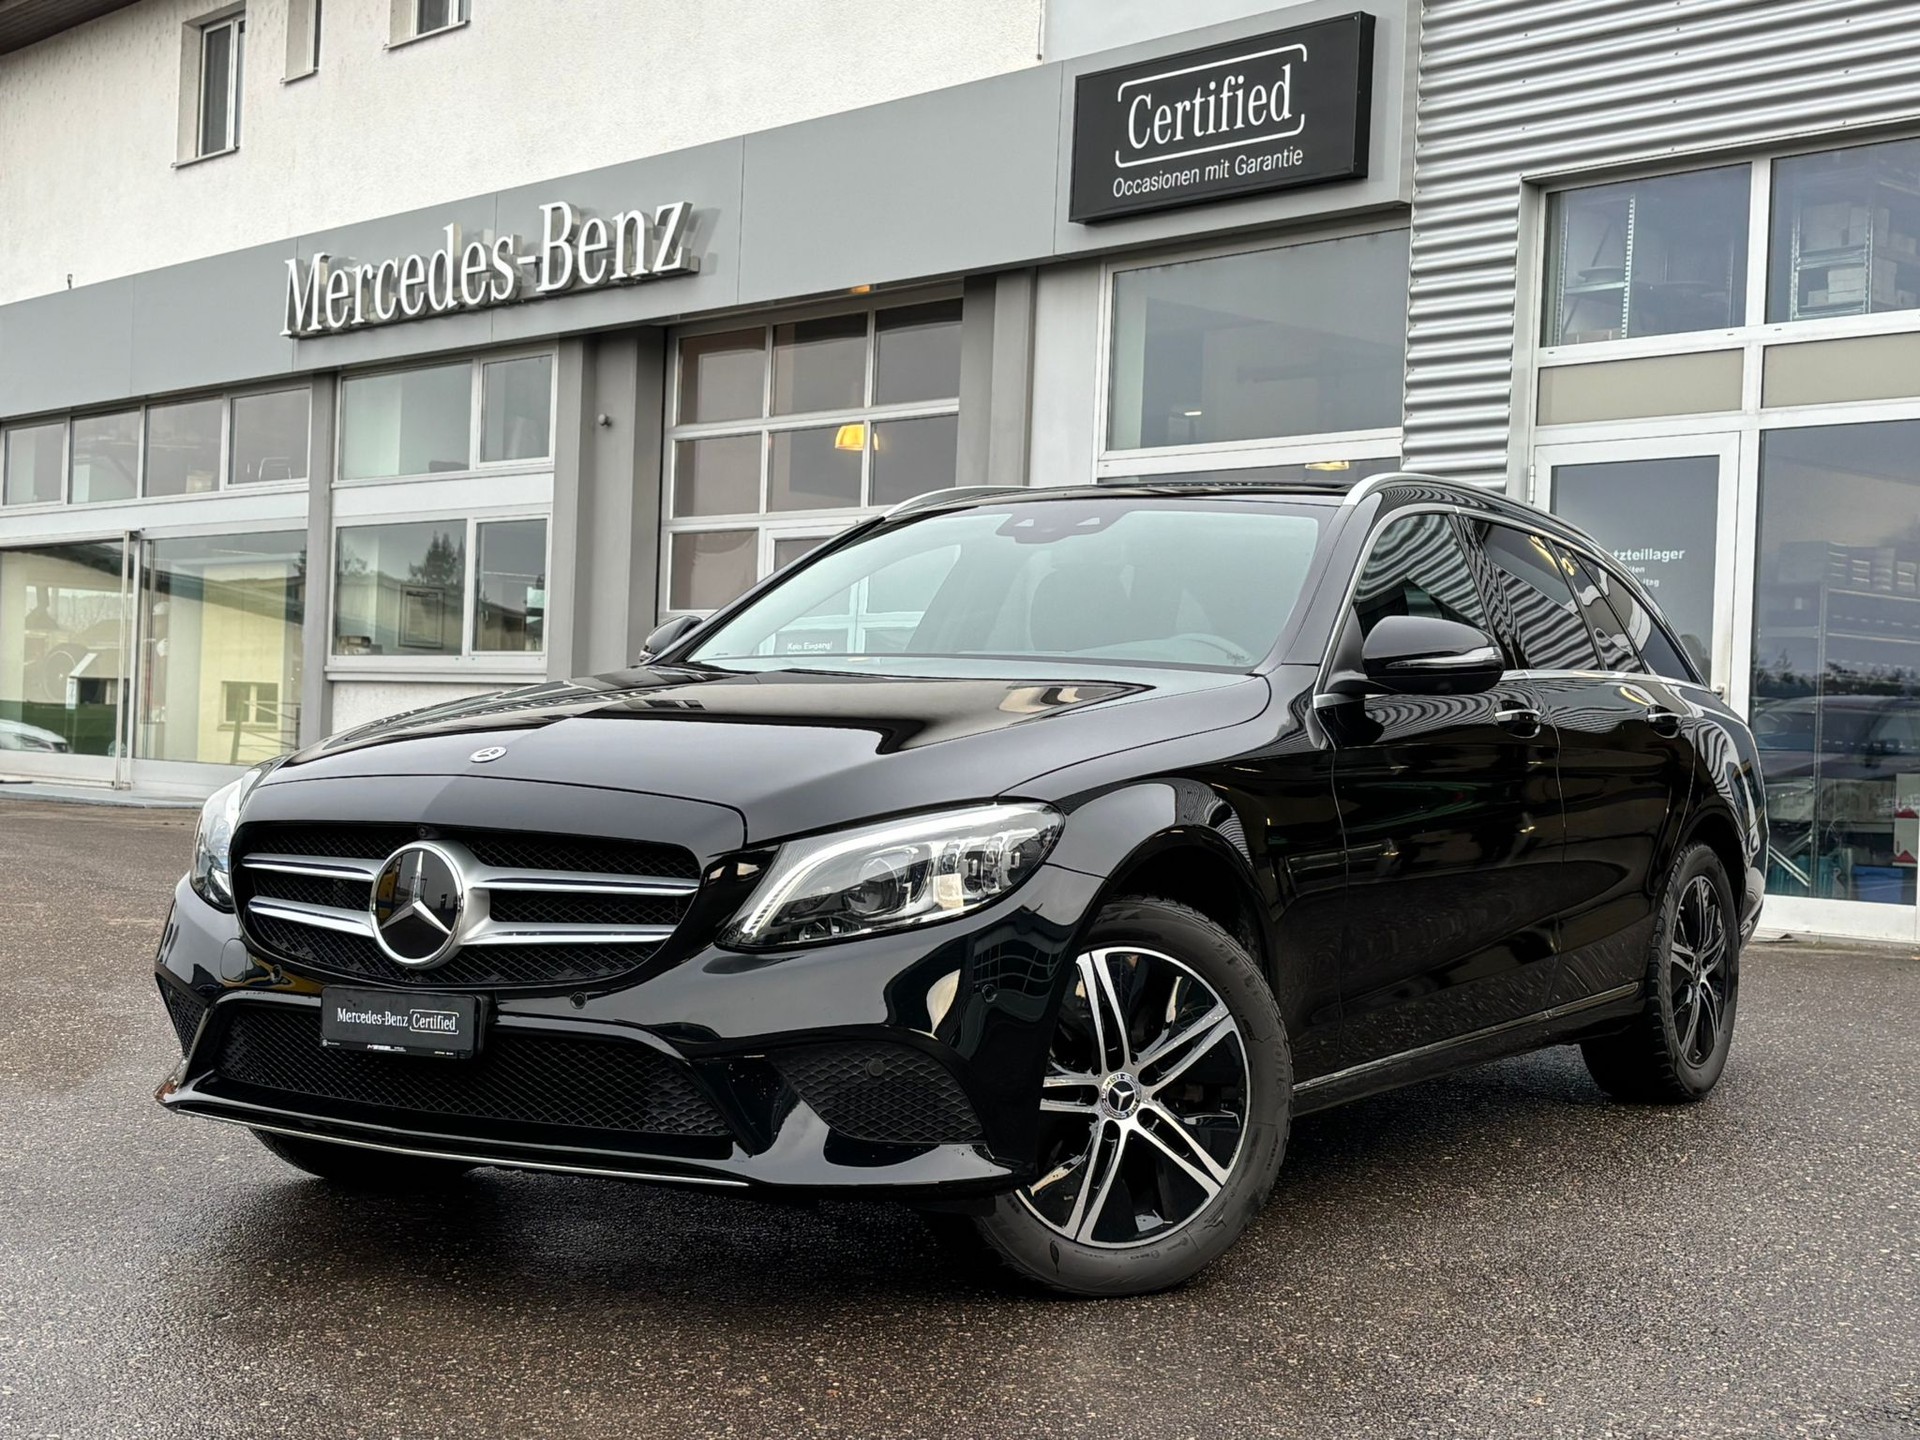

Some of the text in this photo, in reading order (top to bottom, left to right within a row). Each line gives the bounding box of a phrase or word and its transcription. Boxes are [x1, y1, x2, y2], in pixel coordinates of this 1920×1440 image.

[1127, 62, 1293, 149] Certified
[1112, 146, 1304, 198] Occasionen mit Garantie
[279, 200, 697, 337] Mercedes-Benz
[1613, 548, 1685, 563] tzteillager
[337, 1007, 456, 1031] Mercedes-Benz Certified
